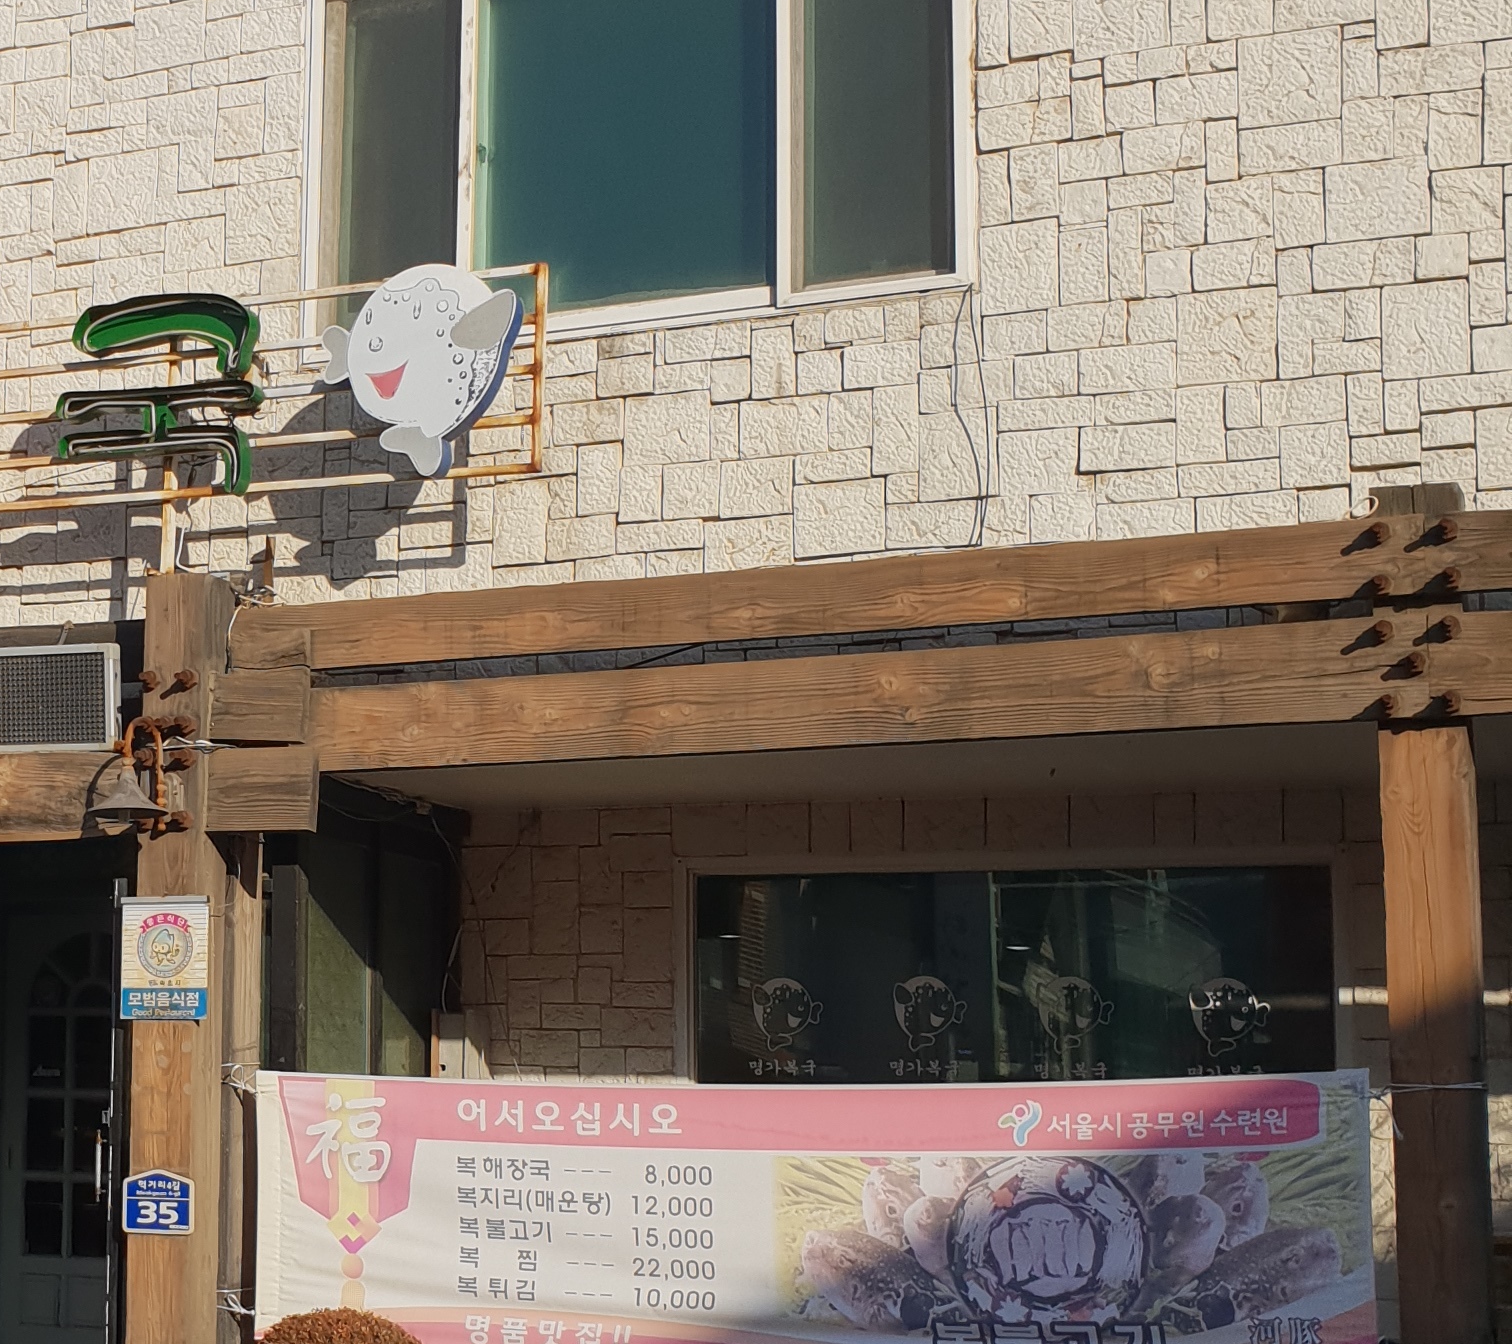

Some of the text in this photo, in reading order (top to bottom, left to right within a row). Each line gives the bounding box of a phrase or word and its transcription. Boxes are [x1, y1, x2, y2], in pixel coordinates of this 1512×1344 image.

[128, 991, 200, 1007] 모범음식점
[748, 1058, 817, 1077] 명가복국
[889, 1058, 960, 1077] 명가복국
[457, 1098, 683, 1137] 어서오십시오
[1046, 1107, 1288, 1141] 서울시 공무원 수련원
[305, 1093, 392, 1183] 福
[456, 1156, 714, 1188] 복해장국 8,000
[136, 1200, 179, 1224] 35
[456, 1186, 714, 1218] 복지리(매운탕) 12,000
[459, 1216, 715, 1250] 복불고기 15,000
[632, 1257, 717, 1282] 22,000
[633, 1287, 717, 1311] 10,000
